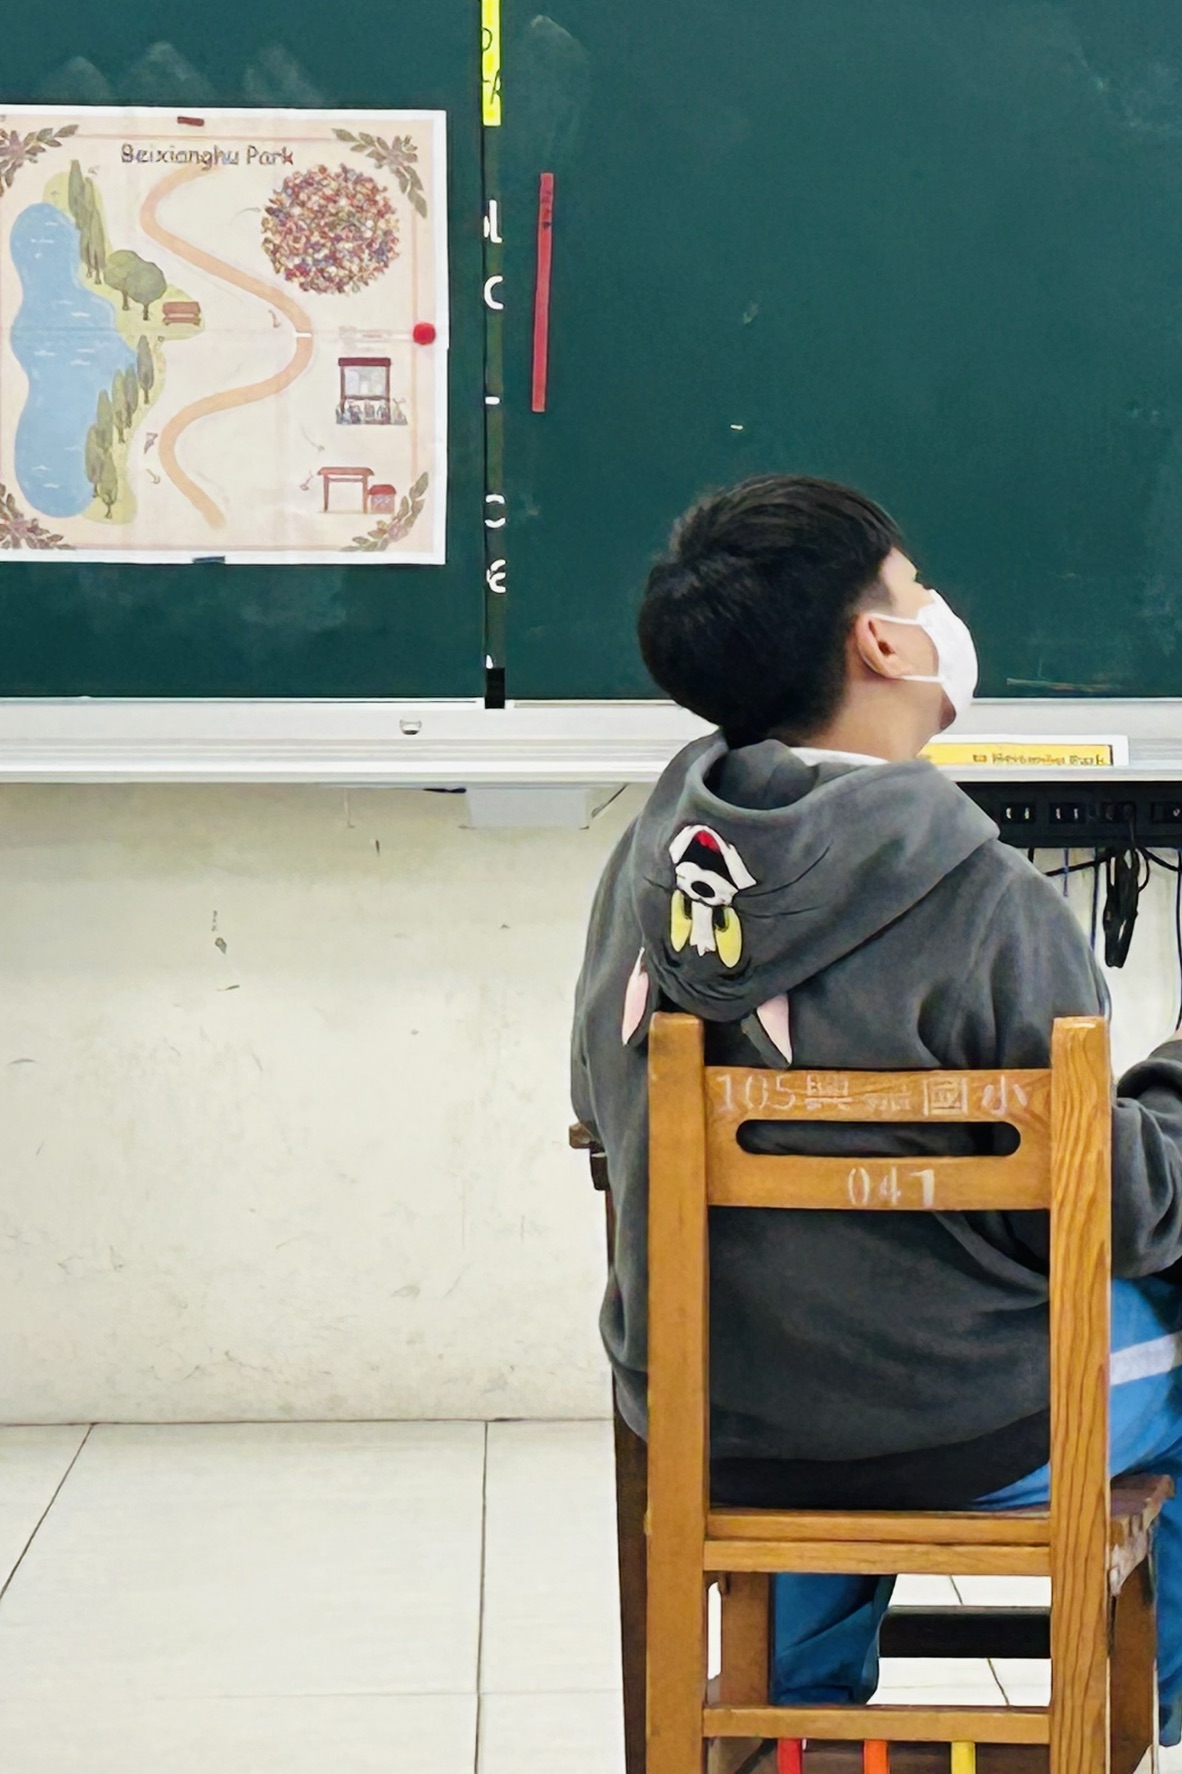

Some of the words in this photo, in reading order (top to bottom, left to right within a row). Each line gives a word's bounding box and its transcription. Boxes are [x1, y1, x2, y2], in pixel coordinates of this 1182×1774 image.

[121, 143, 239, 172] Beixianghu
[246, 145, 294, 166] Park
[847, 1166, 936, 1208] 041
